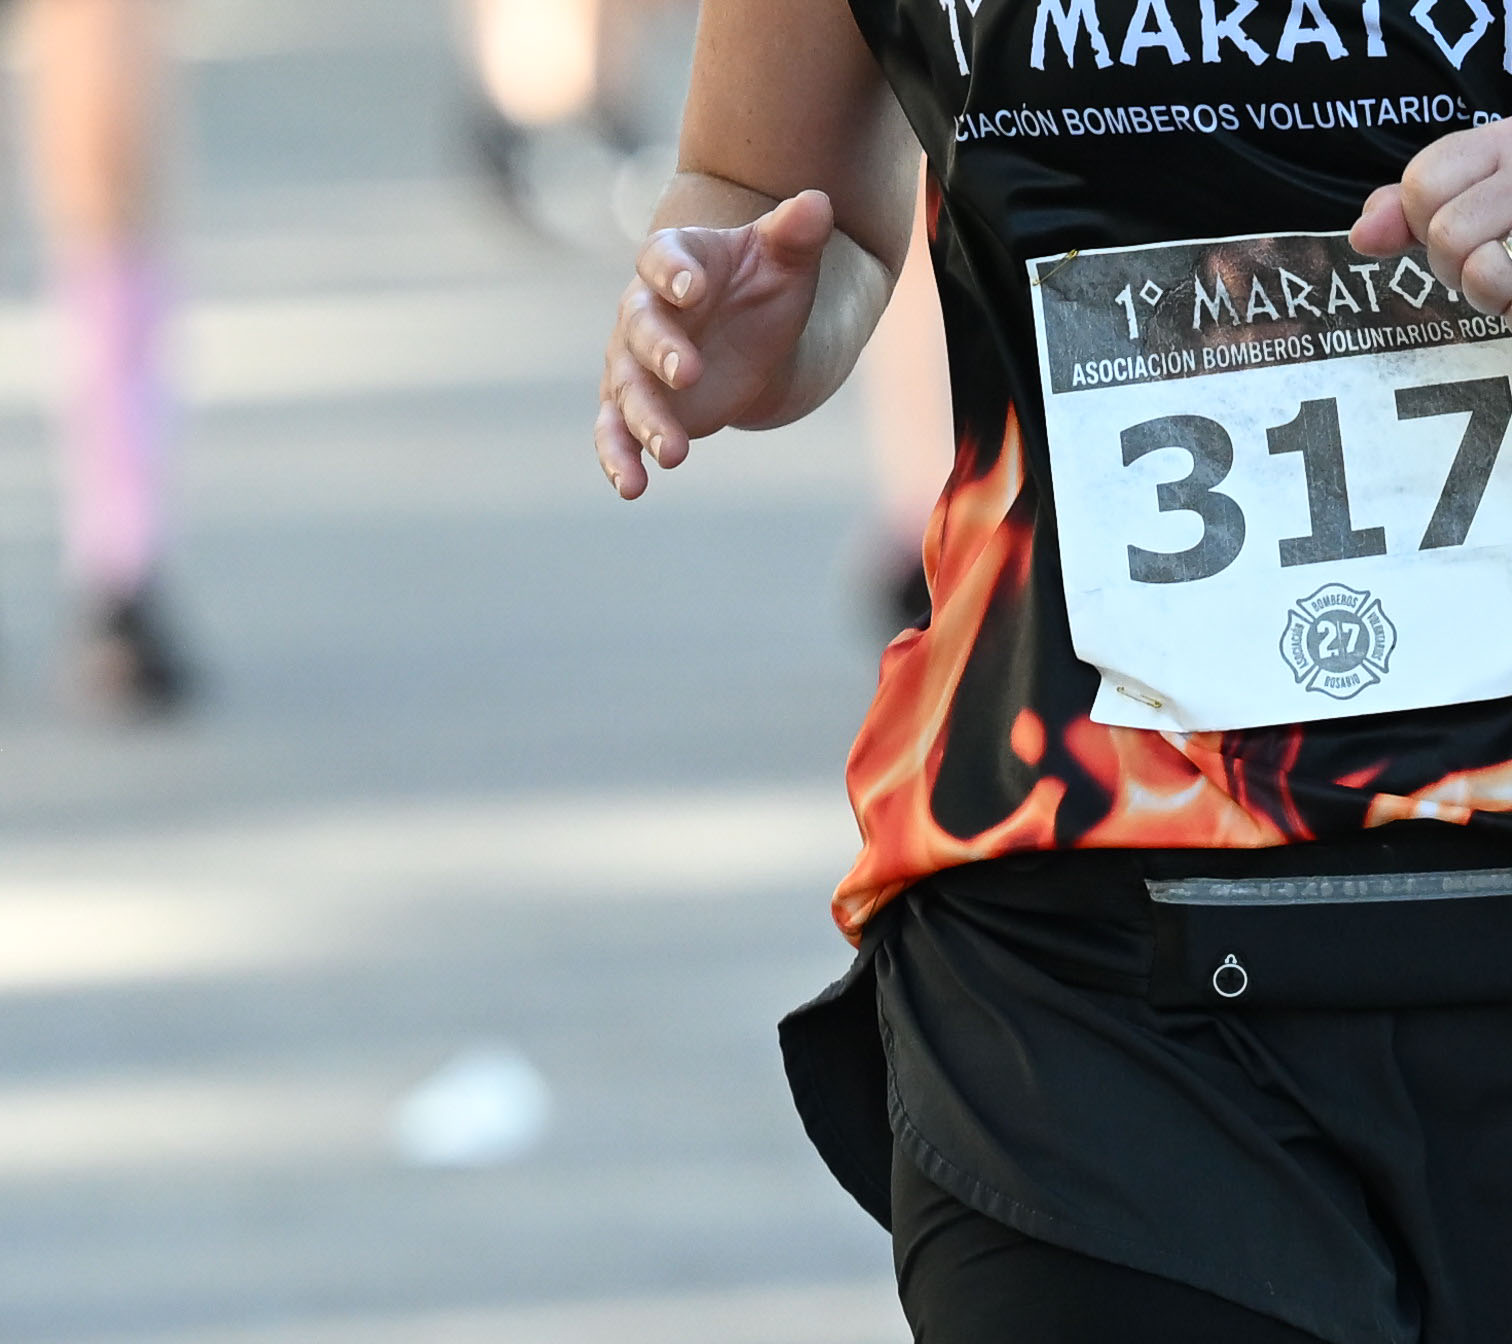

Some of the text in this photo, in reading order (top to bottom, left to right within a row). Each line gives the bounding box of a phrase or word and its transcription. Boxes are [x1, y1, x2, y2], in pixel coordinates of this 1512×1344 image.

[1061, 102, 1241, 136] BOMBEROS
[1072, 344, 1196, 387] ASOCIACIÓN
[1202, 333, 1315, 370] BOMBEROS
[1318, 319, 1454, 356] VOLUNTARIOS
[1316, 619, 1361, 660] 27
